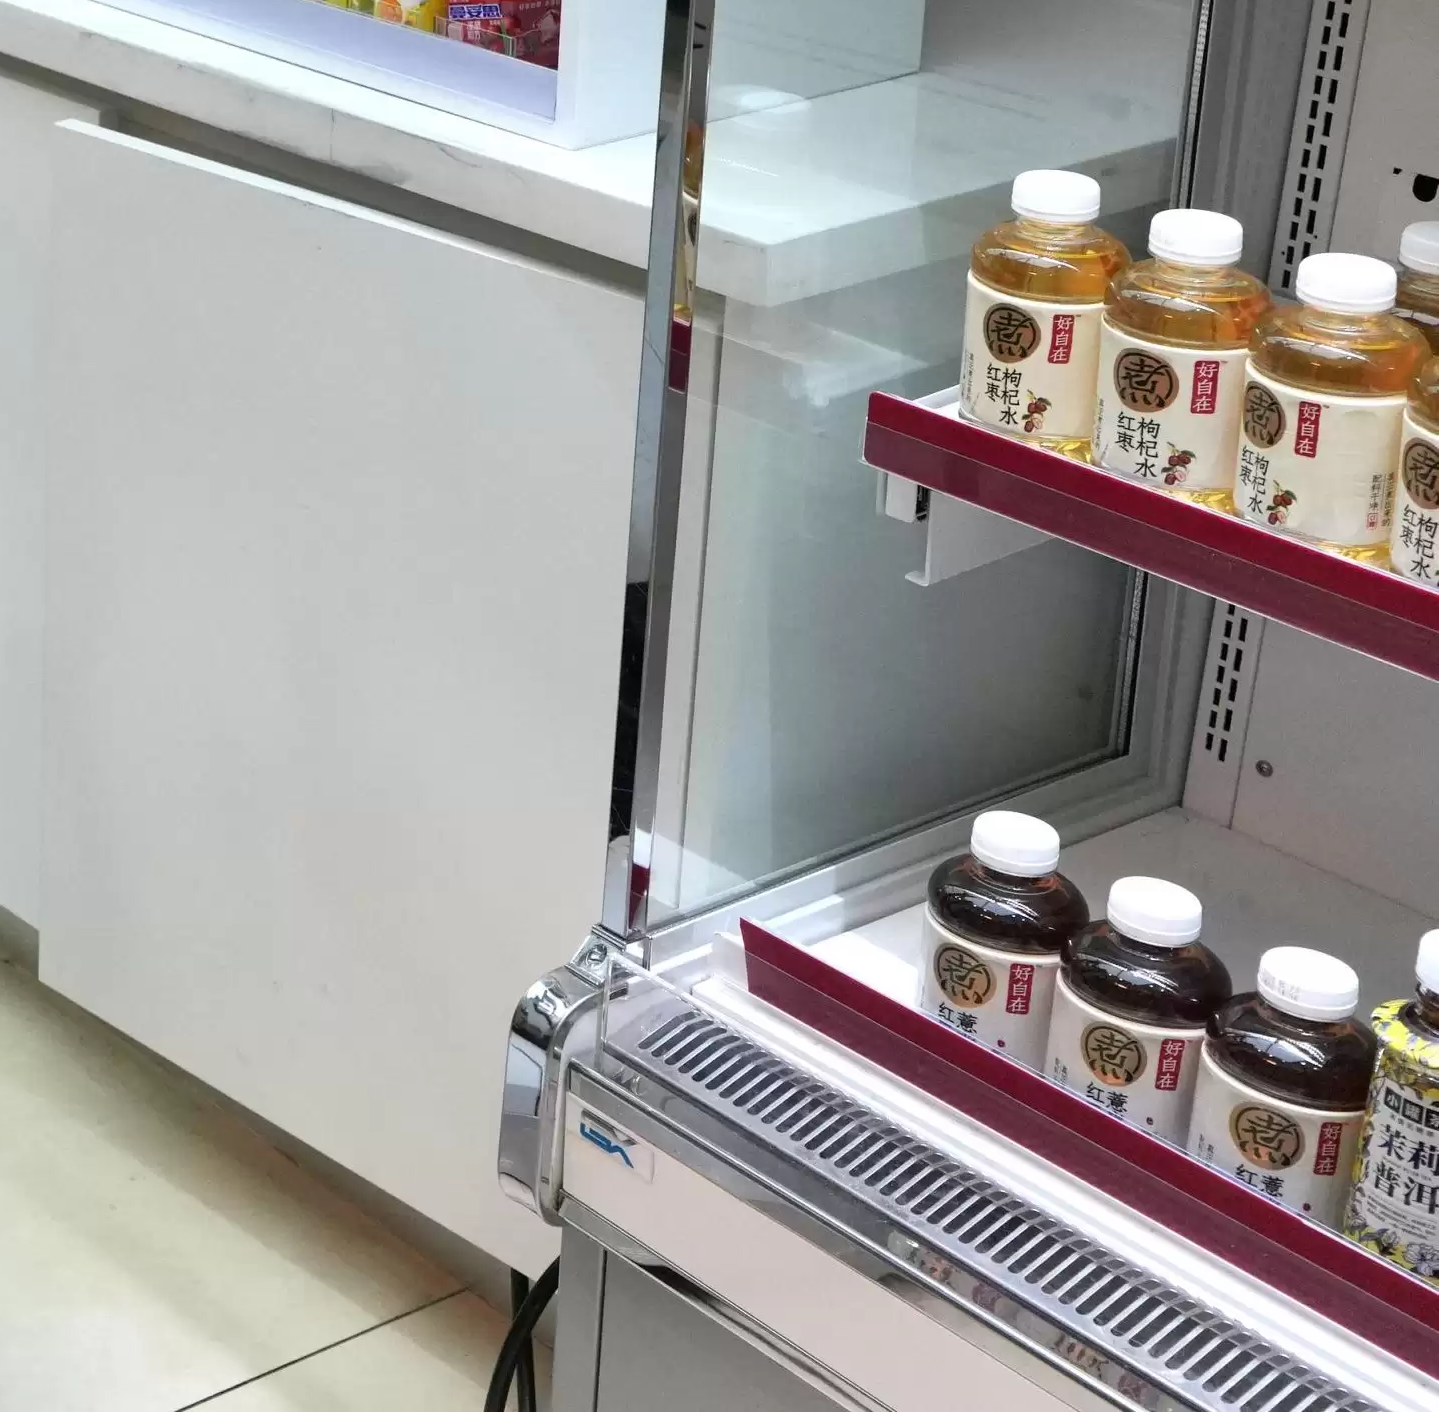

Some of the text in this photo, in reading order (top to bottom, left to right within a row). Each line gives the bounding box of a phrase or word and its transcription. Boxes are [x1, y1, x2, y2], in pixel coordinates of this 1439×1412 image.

[1050, 315, 1074, 363] 好自在
[984, 363, 1002, 403] 红枣
[999, 367, 1023, 426] 枸杞水
[1192, 361, 1219, 413] 好自在
[1114, 411, 1137, 454] 红枣
[1133, 416, 1161, 478] 枸杞水
[1296, 403, 1321, 455] 好自在
[1239, 444, 1255, 487] 红枣
[1247, 451, 1270, 515] 枸杞水
[1399, 503, 1418, 548] 红枣
[1410, 512, 1438, 580] 枸杞水
[1008, 965, 1033, 1013] 好自在
[1156, 1040, 1183, 1089] 好自在
[1316, 1123, 1342, 1174] 好自在
[1377, 1123, 1439, 1177] 茉莉
[1373, 1160, 1439, 1215] 普洱
